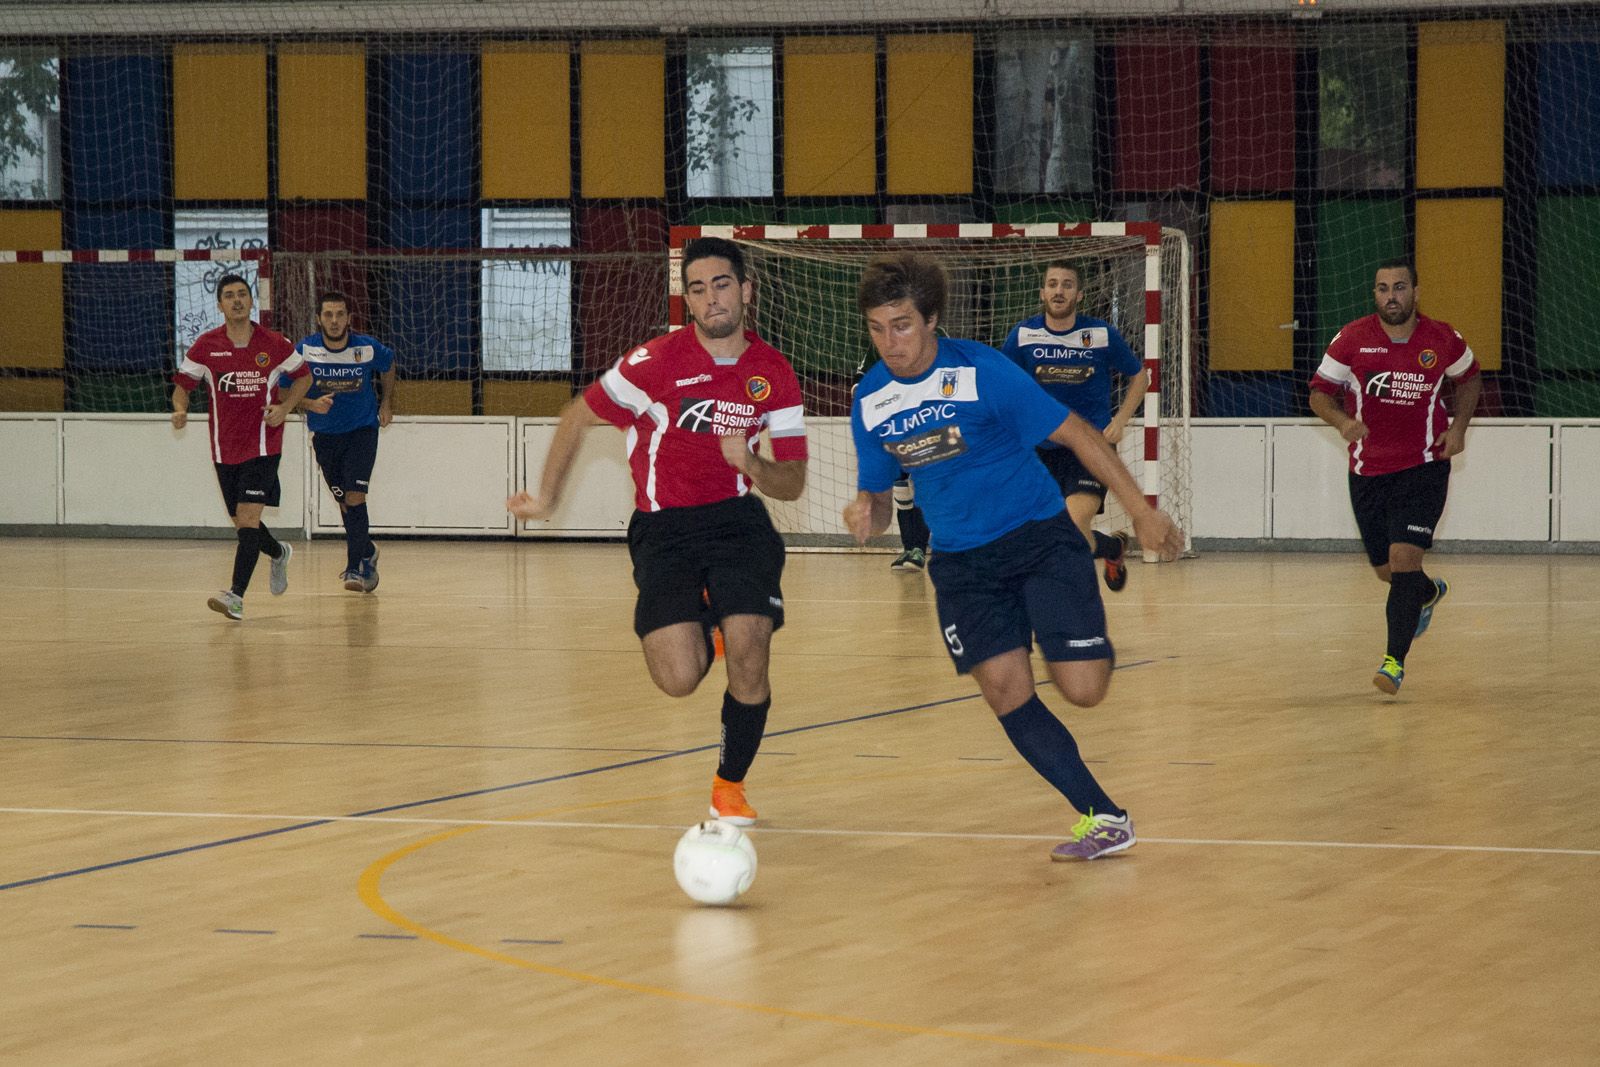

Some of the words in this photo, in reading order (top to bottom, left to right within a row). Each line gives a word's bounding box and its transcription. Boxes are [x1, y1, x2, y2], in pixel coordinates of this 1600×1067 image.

[1033, 348, 1093, 359] OLIMPYC
[313, 367, 363, 377] OLIMPYC
[1392, 371, 1425, 382] WORLD
[236, 377, 268, 385] BUSINESS
[1391, 380, 1433, 391] BUSINESS
[236, 384, 261, 392] TRAVEL
[1391, 389, 1422, 399] TRAVEL
[717, 400, 755, 416] WORLD
[713, 412, 760, 427] BUSINES
[879, 403, 956, 437] OLIMPYC
[712, 424, 747, 436] TRAVE
[944, 624, 965, 656] 5
